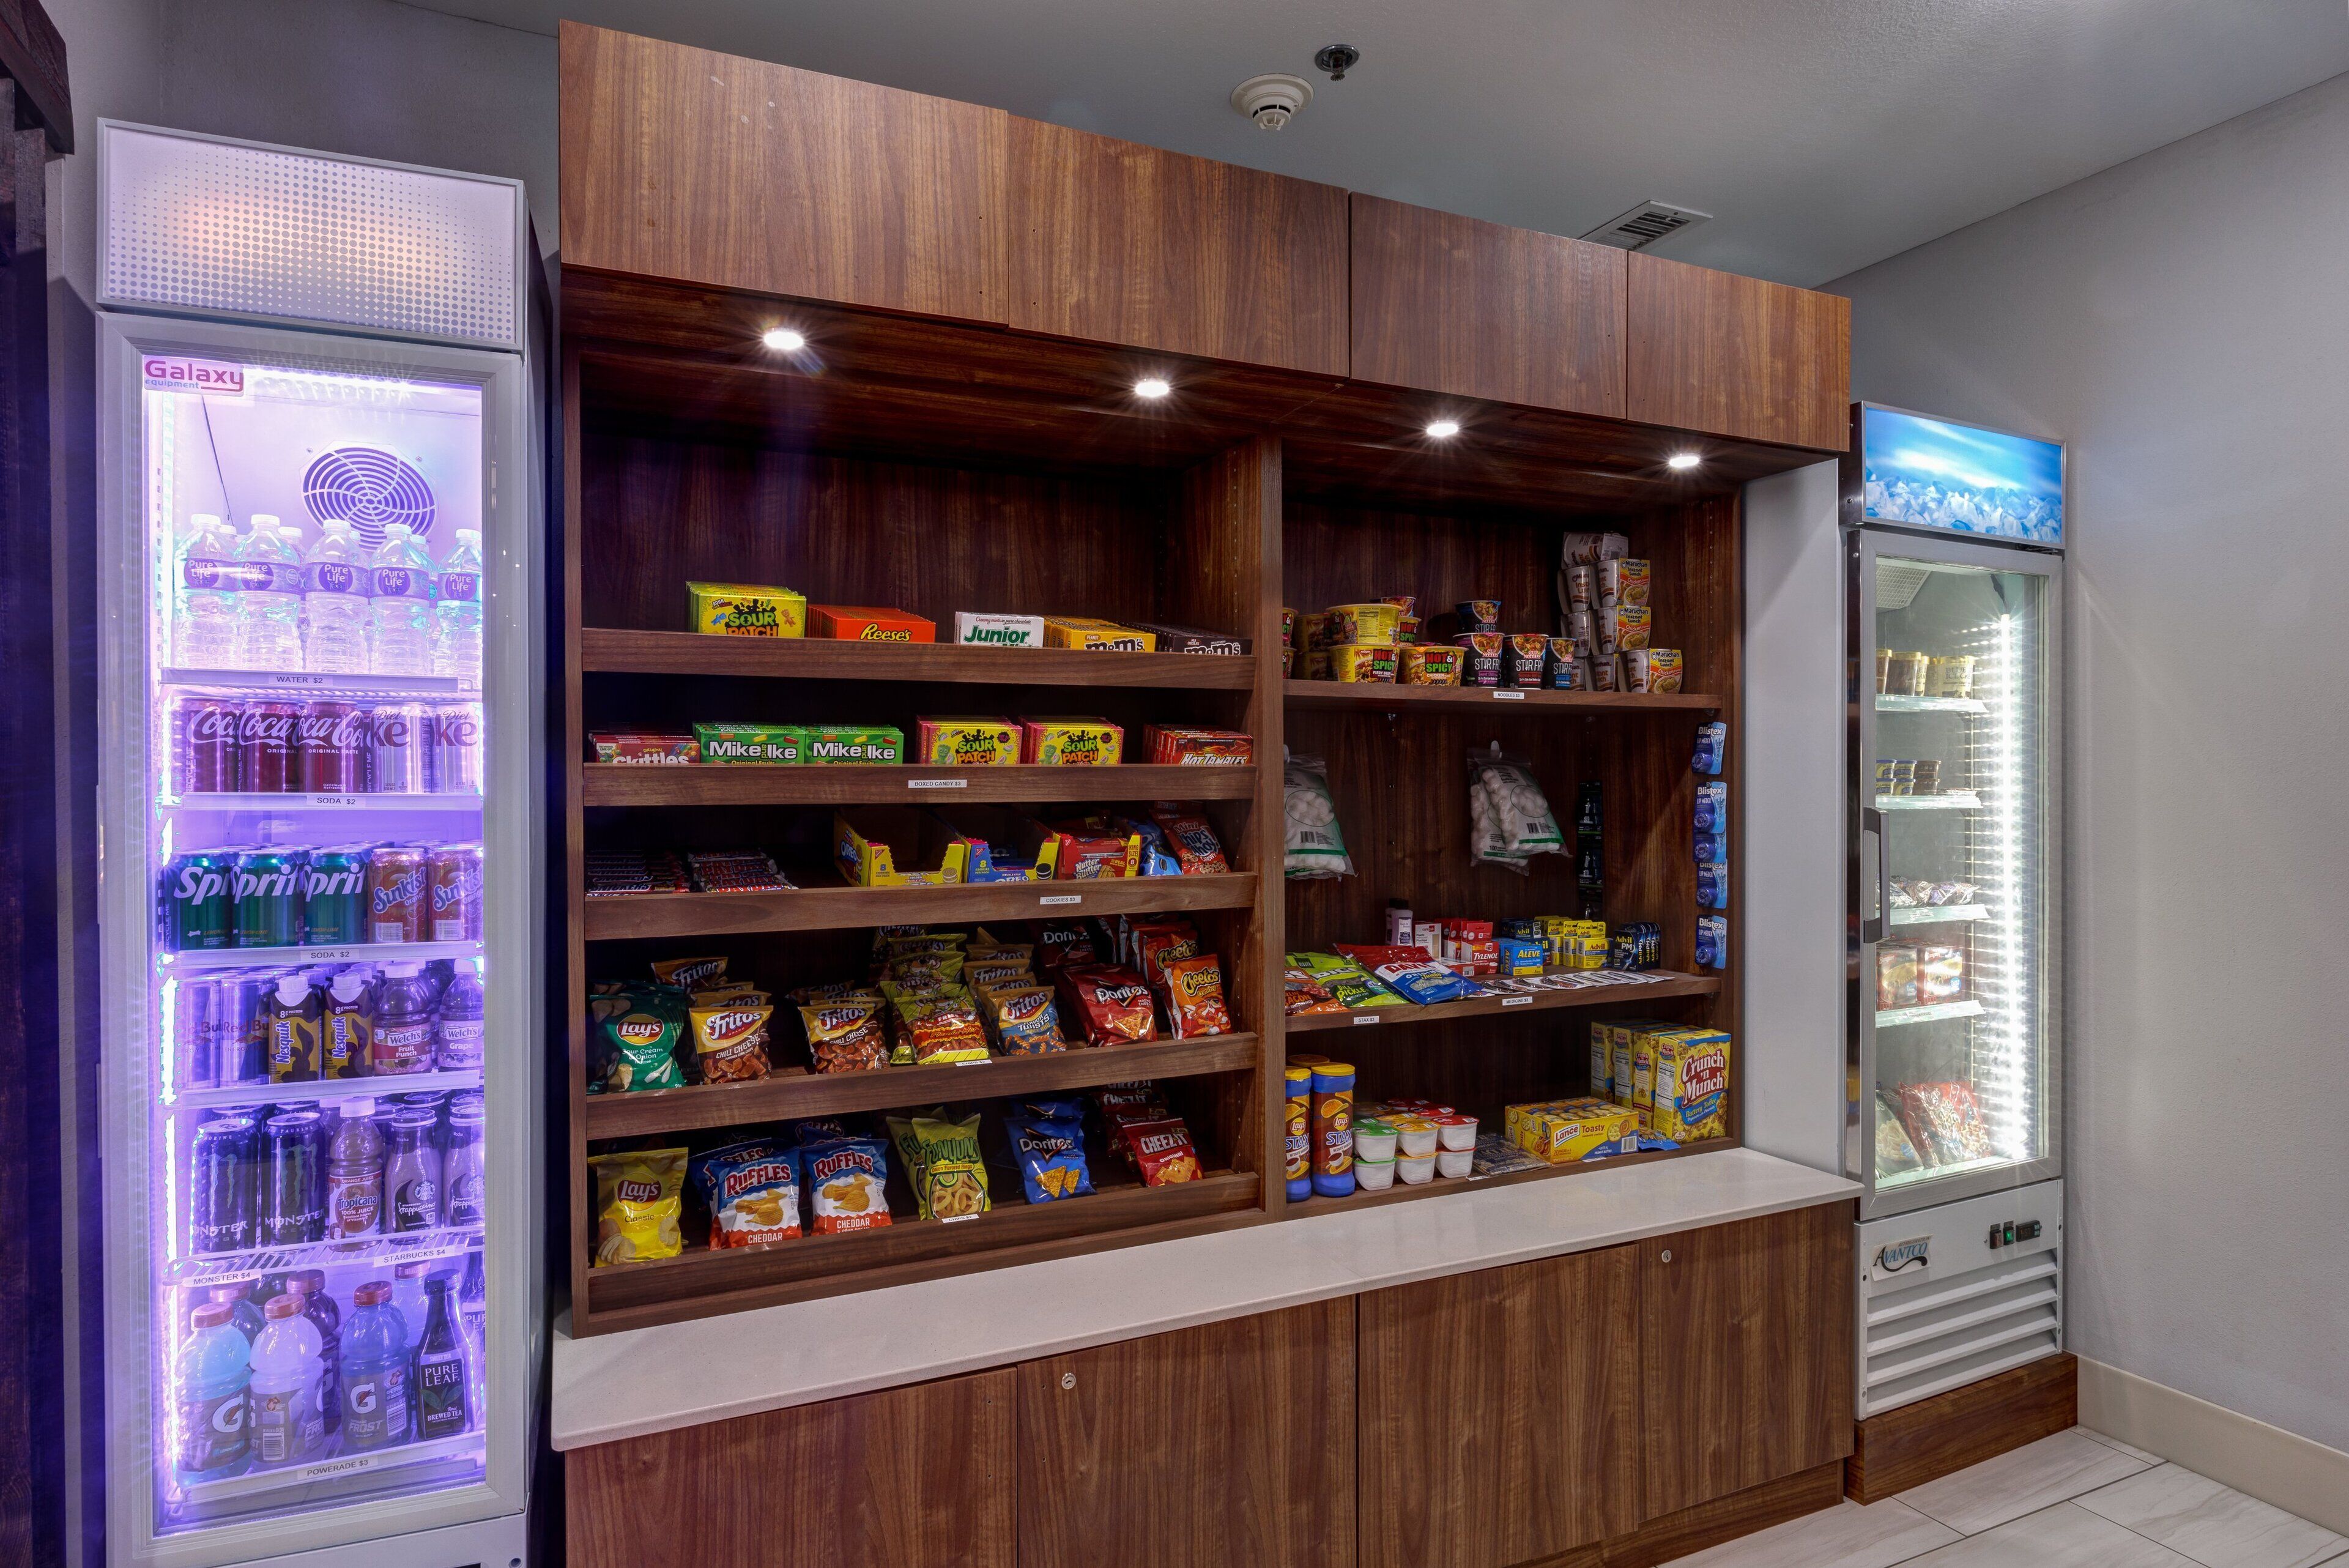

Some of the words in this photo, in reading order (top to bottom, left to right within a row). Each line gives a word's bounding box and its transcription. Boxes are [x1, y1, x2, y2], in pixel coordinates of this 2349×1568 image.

[145, 360, 243, 392] Galaxy
[145, 379, 199, 389] equipment
[325, 564, 348, 574] Pure
[382, 569, 406, 578] Pure
[327, 573, 346, 584] Life
[385, 578, 403, 588] Life
[450, 574, 472, 583] Pure
[452, 582, 470, 592] Life
[728, 612, 776, 626] SOUR
[727, 626, 779, 637] PATCH
[859, 623, 913, 642] Reese's
[963, 625, 1031, 644] Junior
[1374, 649, 1392, 661] HOT
[1426, 653, 1447, 663] HOT
[1373, 661, 1395, 670] SPICY
[1426, 663, 1452, 672] SPICY
[313, 676, 324, 685] $2
[376, 710, 401, 720] Diet
[443, 710, 470, 720] Diet
[1698, 726, 1723, 737] Blistex
[709, 741, 762, 757] Mike
[766, 744, 797, 759] Ike
[812, 741, 862, 758] Mike
[866, 745, 896, 760] Ike
[957, 739, 995, 752] SOUR
[1063, 740, 1098, 752] SOUR
[957, 751, 996, 764] PATCH
[1062, 751, 1099, 764] PATCH
[1698, 787, 1723, 797] Blistex
[1173, 822, 1199, 833] Mini
[1075, 858, 1100, 871] Nutter
[1075, 865, 1102, 879] Butter
[373, 867, 426, 913] Sunkist
[1699, 918, 1723, 931] Blistex
[1518, 949, 1541, 959] ALEVE
[672, 962, 718, 992] Fritos
[1181, 967, 1221, 996] Cheetos
[1095, 986, 1148, 1003] Doritos
[1337, 987, 1366, 998] PICKLE
[1006, 992, 1047, 1019] Fritos
[707, 1012, 761, 1039] Fritos
[818, 1008, 866, 1030] Fritos
[1018, 1014, 1050, 1031] TWISTS
[1023, 1014, 1044, 1025] FLAVOR
[448, 1027, 478, 1038] Welch's
[621, 1022, 661, 1037] Lay's
[846, 1027, 868, 1040] CHEESE
[276, 1020, 294, 1065] Nesquik
[332, 1016, 351, 1059] Nesquik
[389, 1031, 421, 1045] Welch's
[716, 1050, 732, 1059] CHILI
[733, 1033, 760, 1053] CHEESE
[1682, 1050, 1724, 1082] Crunch
[1700, 1069, 1709, 1079] 'n
[1683, 1072, 1723, 1105] Munch
[1686, 1106, 1702, 1117] Buttery
[1704, 1098, 1716, 1109] Toffee
[1335, 1117, 1348, 1127] Lay's
[1326, 1129, 1352, 1145] STAX
[1556, 1126, 1578, 1142] Lance
[1581, 1124, 1605, 1134] Toasty
[1019, 1137, 1074, 1153] Doritos
[1140, 1133, 1188, 1154] CHEEZ-IT
[814, 1151, 874, 1180] RUFFLES
[725, 1164, 792, 1198] RUFFLES
[620, 1181, 659, 1203] Lay's
[338, 1196, 377, 1210] Tropicana
[625, 1214, 655, 1223] Classic
[837, 1217, 870, 1228] CHEDDAR
[748, 1233, 783, 1244] CHEDDAR
[384, 1250, 434, 1263] STARBUCKS
[1872, 1242, 1928, 1268] AVANTCO
[193, 1274, 239, 1284] MONSTER
[425, 1364, 458, 1377] PURE
[426, 1374, 459, 1386] LEAF
[428, 1412, 451, 1421] BREWED
[349, 1420, 385, 1433] FROST
[306, 1462, 357, 1476] POWERADE
[358, 1459, 369, 1468] $3
